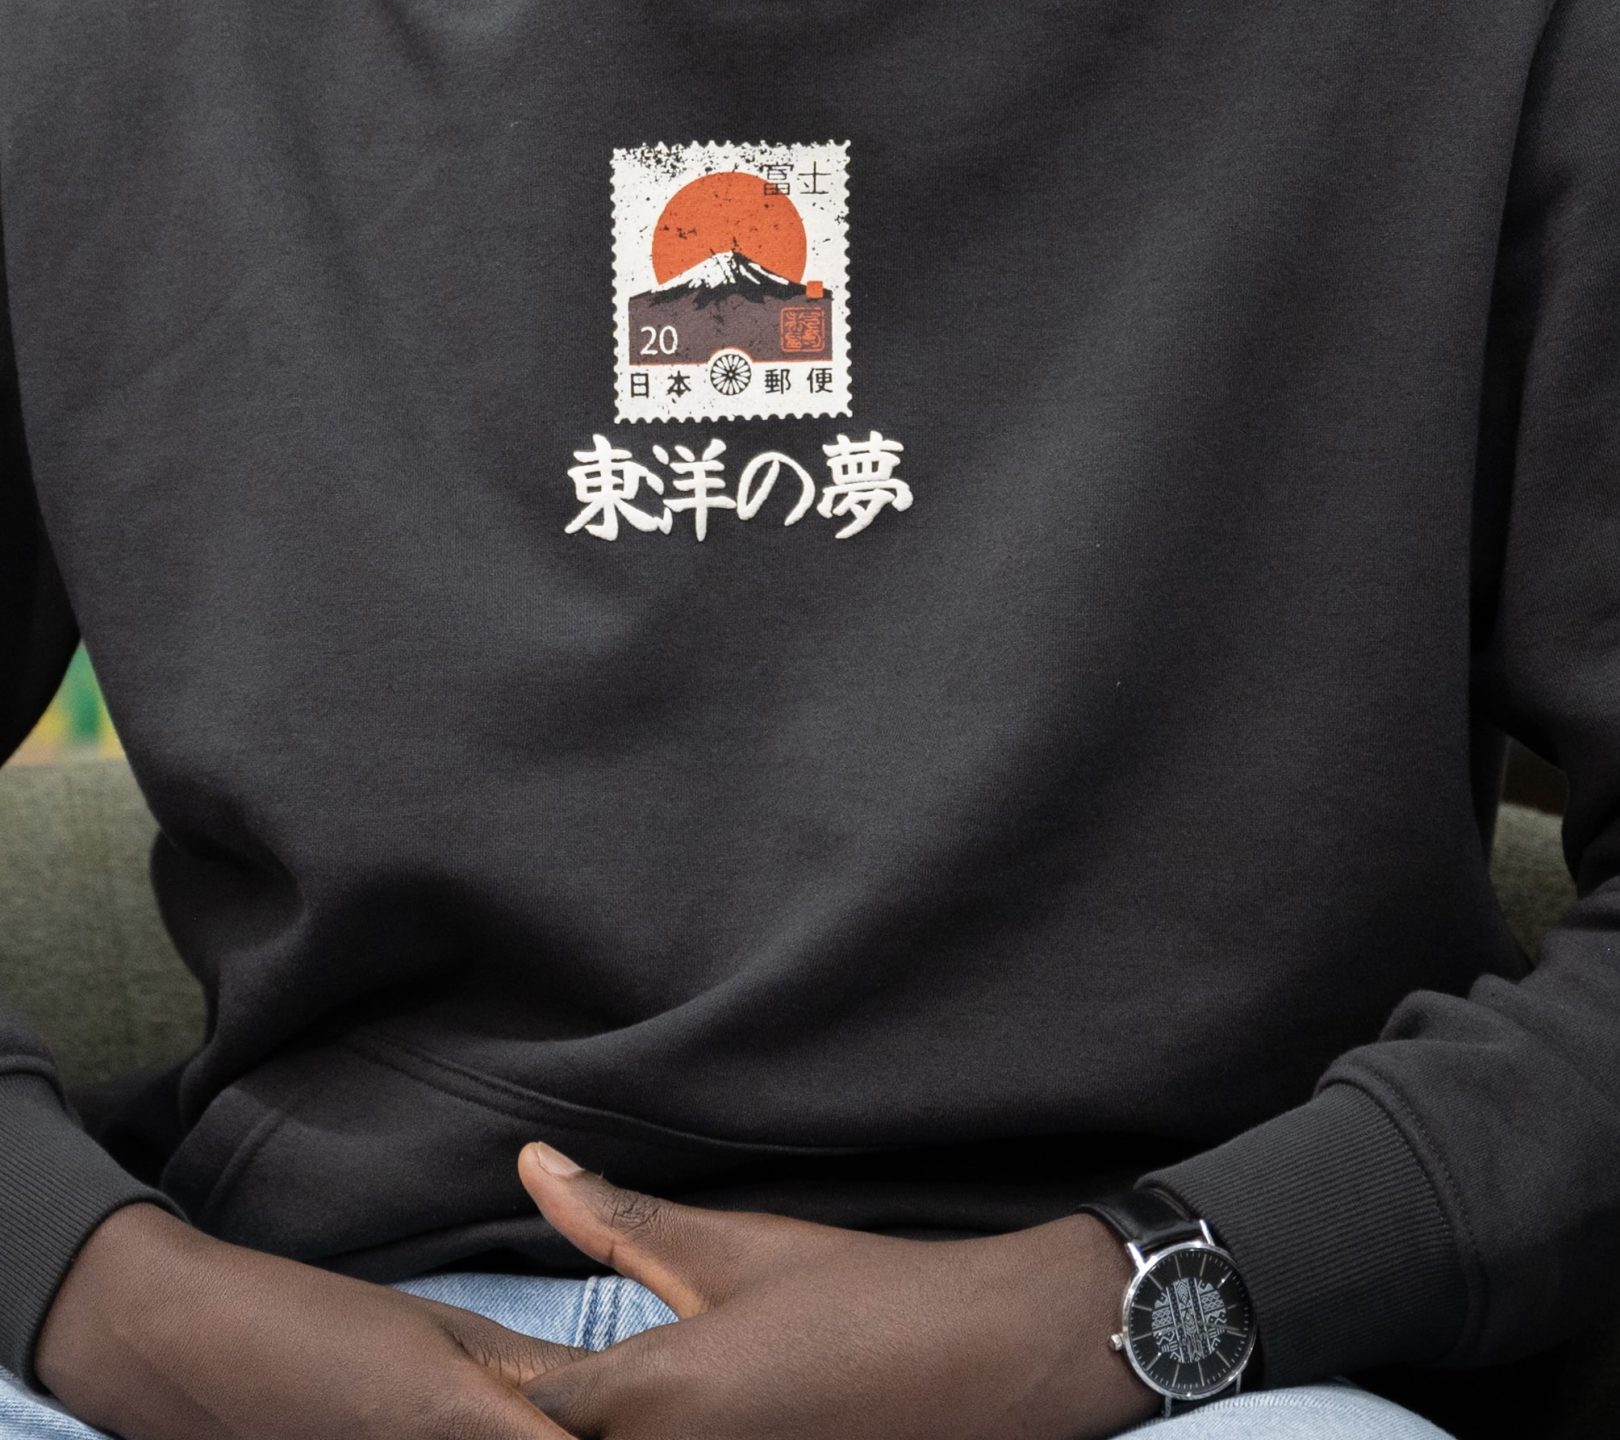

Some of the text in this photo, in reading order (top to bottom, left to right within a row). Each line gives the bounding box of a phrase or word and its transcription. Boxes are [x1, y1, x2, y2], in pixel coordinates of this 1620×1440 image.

[760, 161, 832, 196] 富士
[640, 326, 678, 356] 20
[631, 368, 834, 398] 日本 郵便
[565, 431, 914, 542] 東洋の夢
